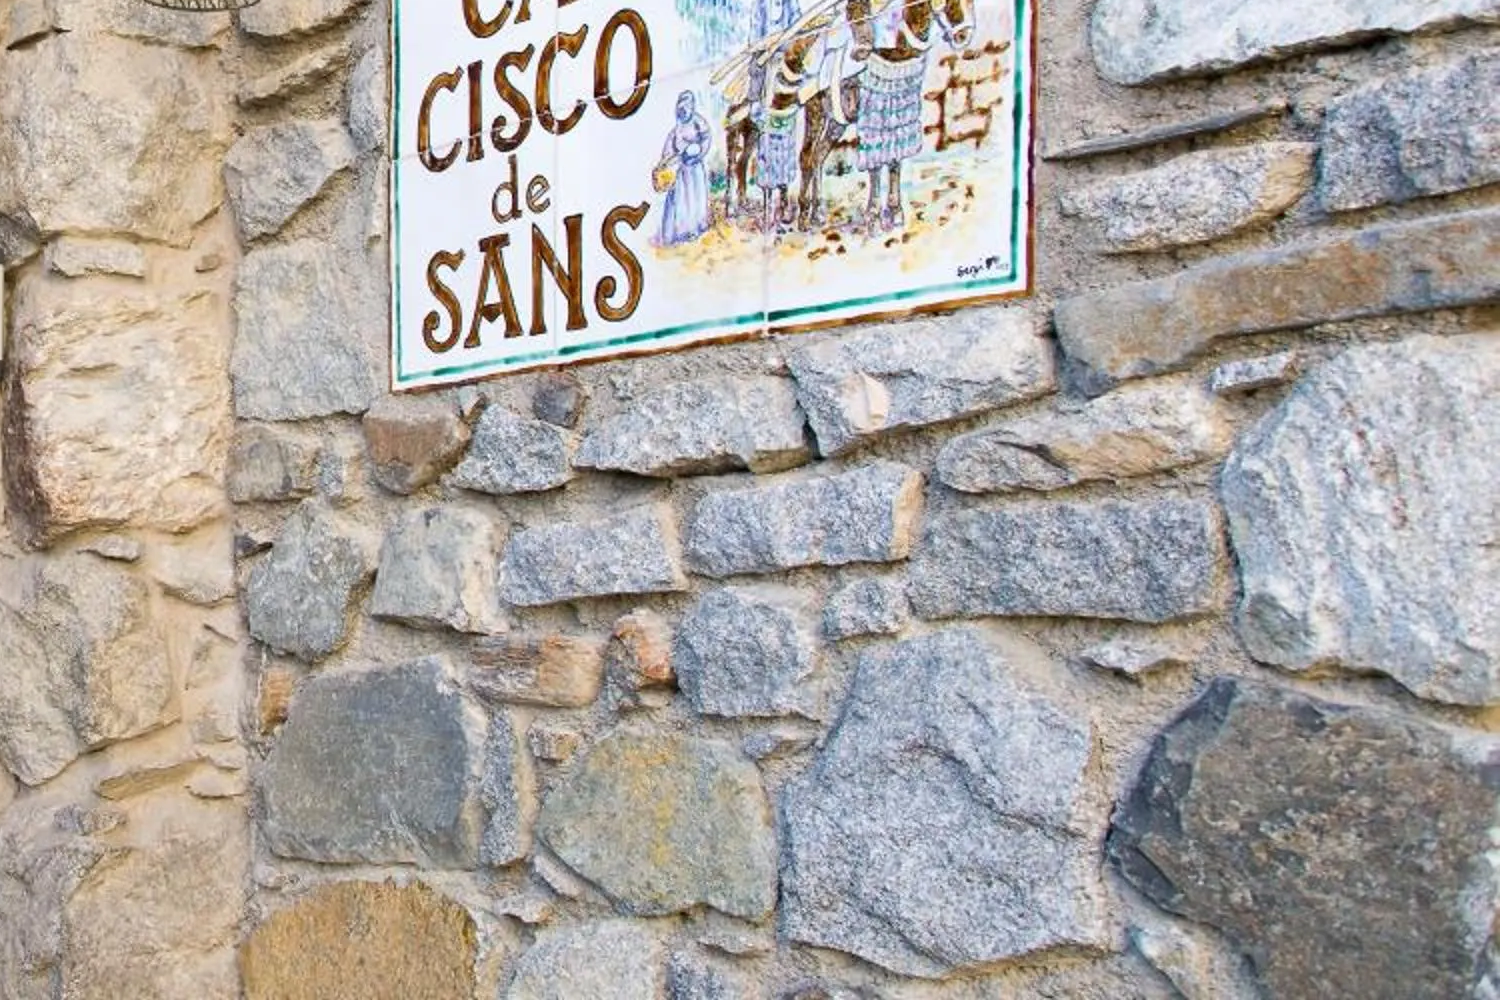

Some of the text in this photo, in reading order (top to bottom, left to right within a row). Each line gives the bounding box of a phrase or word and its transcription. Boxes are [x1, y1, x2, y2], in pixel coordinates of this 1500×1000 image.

[417, 8, 653, 173] CISCO
[491, 153, 551, 224] de
[422, 201, 651, 355] SANS
